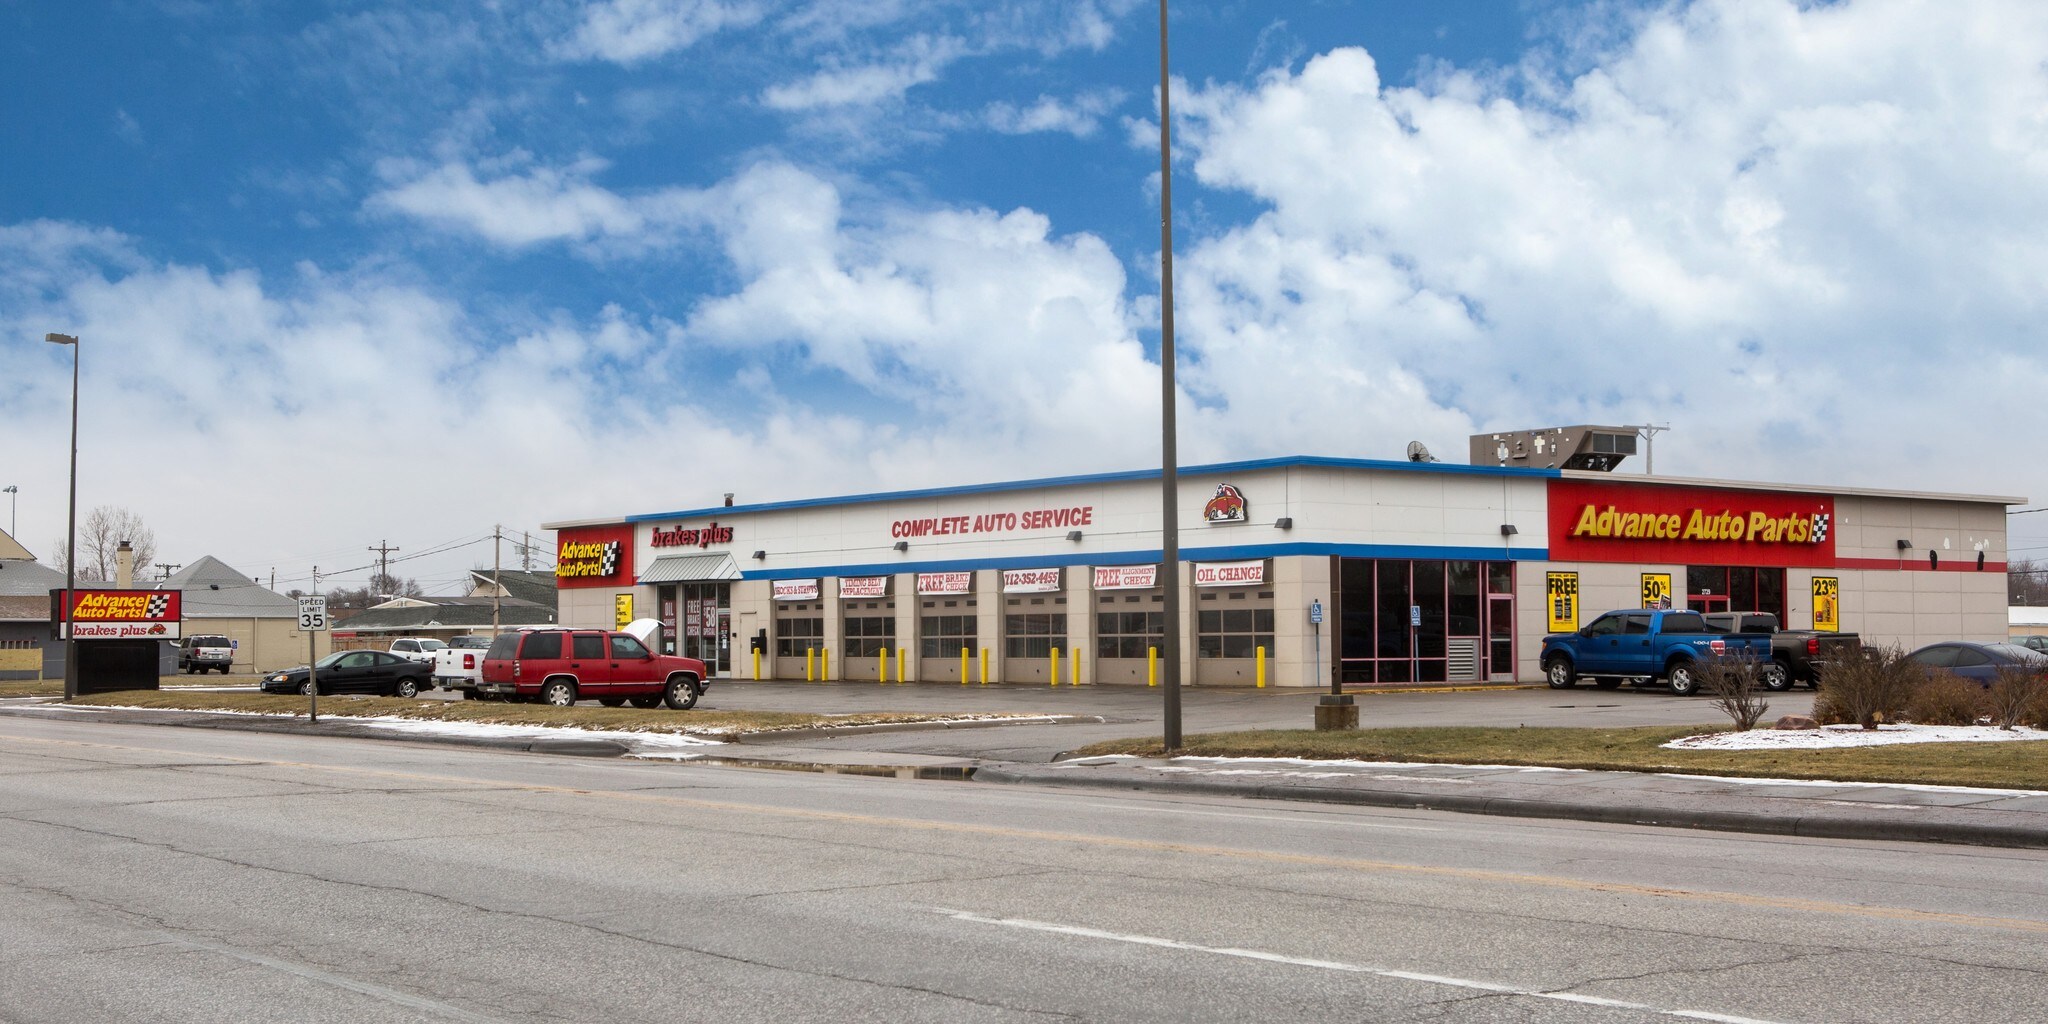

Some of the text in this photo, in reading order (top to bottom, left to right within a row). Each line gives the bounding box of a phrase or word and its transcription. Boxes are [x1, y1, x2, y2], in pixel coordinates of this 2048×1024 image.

[892, 506, 1093, 538] COMPLETE AUTO SERVICE
[1573, 504, 1810, 543] Advance Auto Parts
[651, 522, 732, 548] brakes plus
[560, 541, 600, 560] Advance
[555, 561, 599, 577] Auto Parts
[1121, 567, 1155, 575] ALIGNMENT
[1197, 566, 1262, 582] OIL CHANGE
[919, 574, 945, 591] FREE
[945, 573, 969, 583] BRAKE
[1004, 571, 1059, 586] 712-352-4455
[1095, 568, 1121, 587] FREE
[1123, 575, 1151, 585] CHECK
[945, 582, 968, 591] CHECK
[1548, 578, 1577, 594] FREE
[80, 593, 144, 607] Advance
[687, 600, 700, 613] FREE
[73, 607, 142, 618] Auto Parts
[665, 602, 674, 616] OIL
[301, 614, 323, 627] 35
[687, 615, 700, 624] BRAKE
[73, 625, 147, 637] brakes plus
